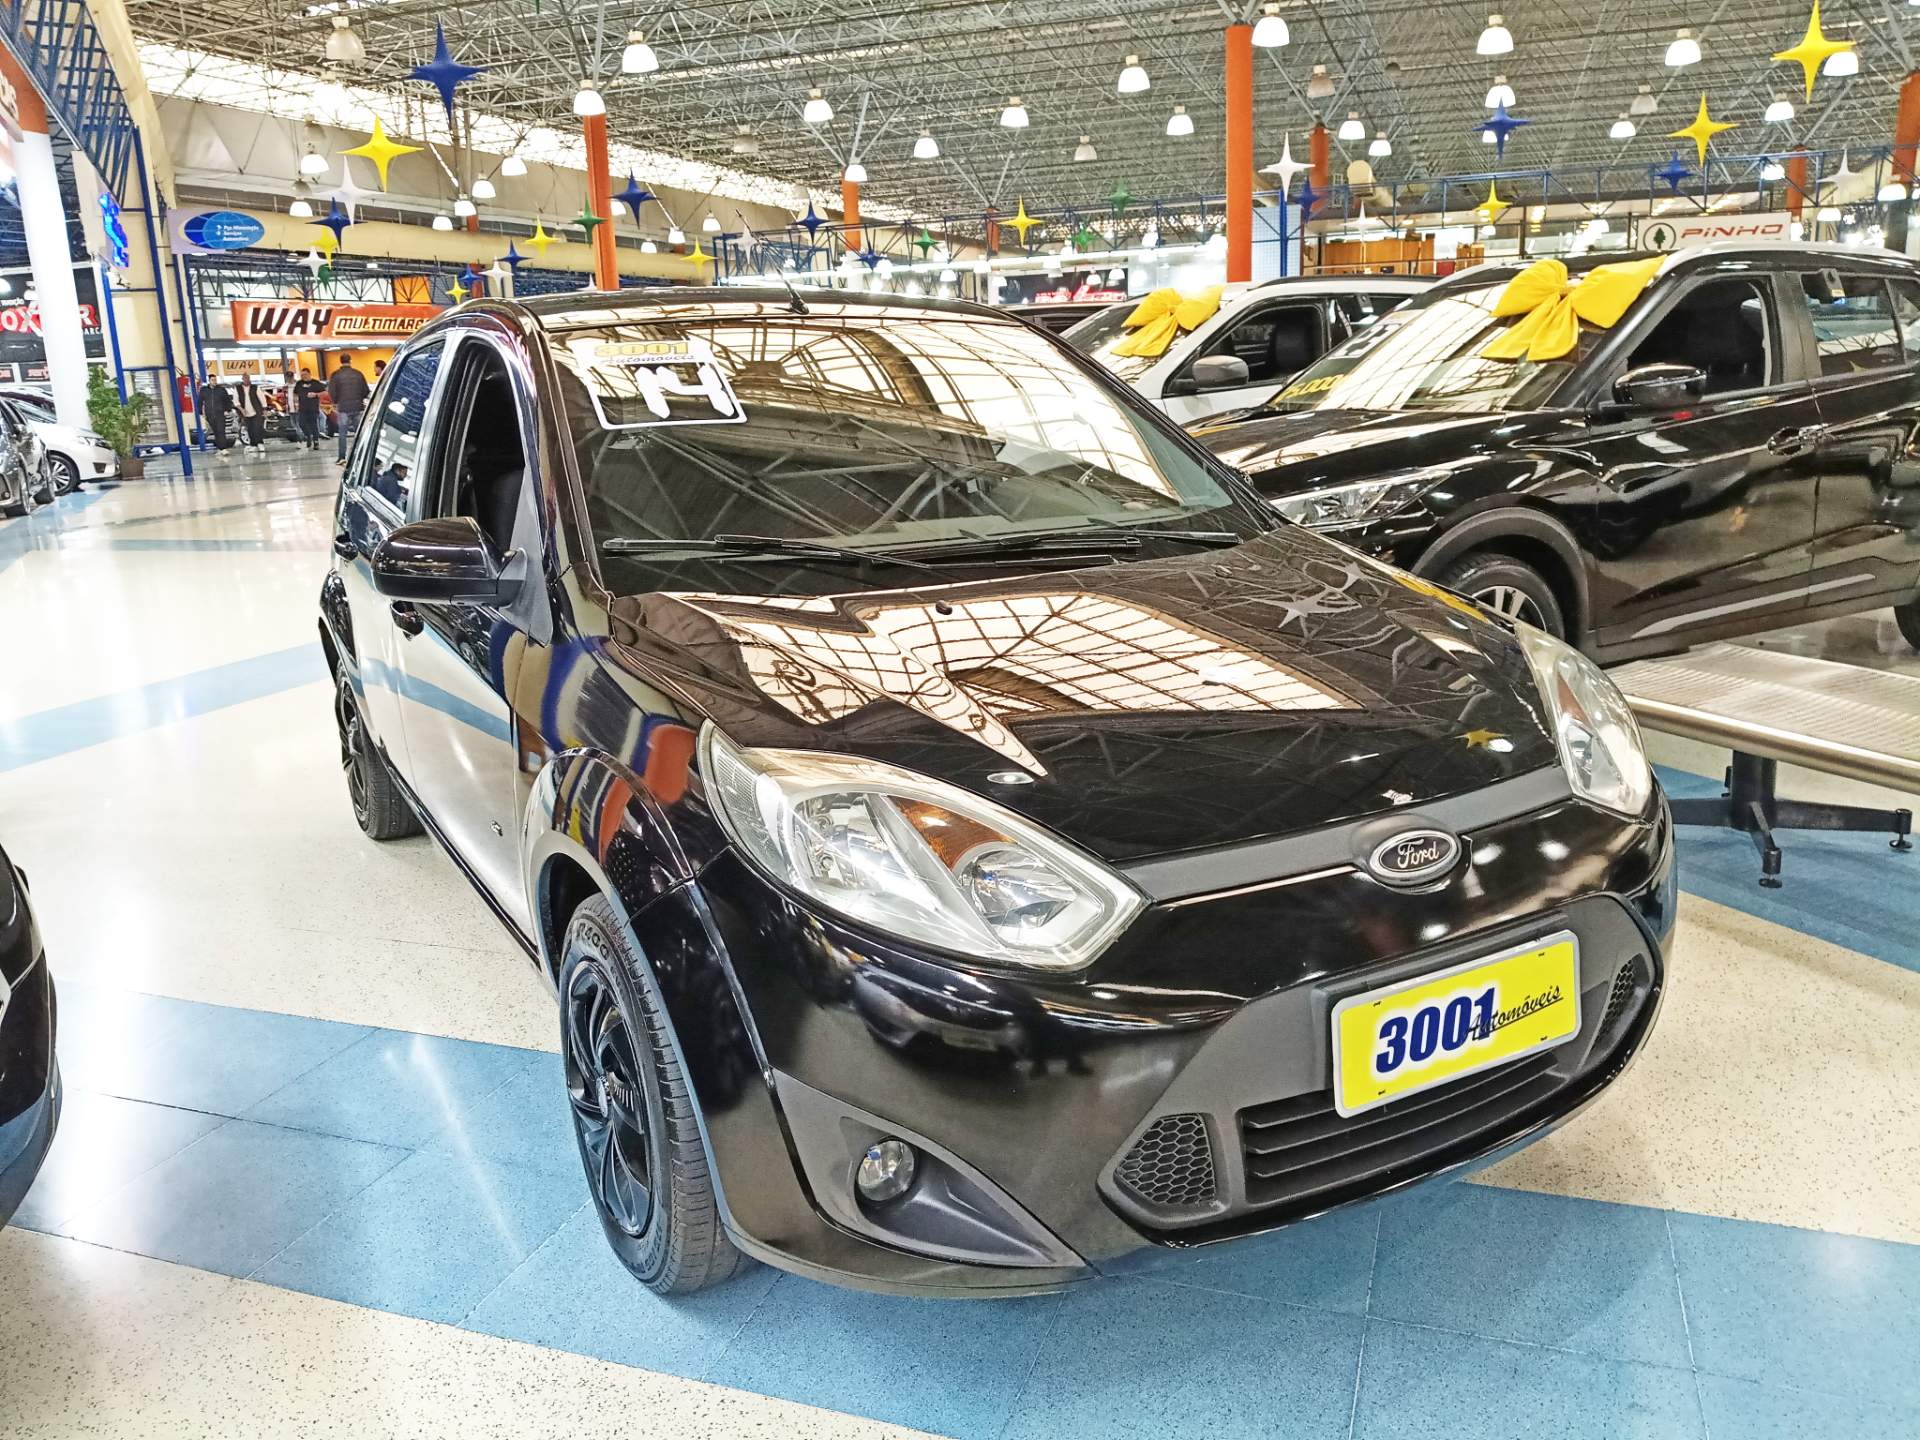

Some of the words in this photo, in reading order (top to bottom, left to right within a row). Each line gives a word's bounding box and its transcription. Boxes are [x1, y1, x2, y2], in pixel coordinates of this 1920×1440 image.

[250, 307, 333, 335] WAY
[226, 360, 256, 369] WAY
[634, 365, 735, 419] 14
[1397, 838, 1440, 868] Ford
[1375, 987, 1496, 1074] 3001
[1464, 985, 1563, 1041] Automóveis
